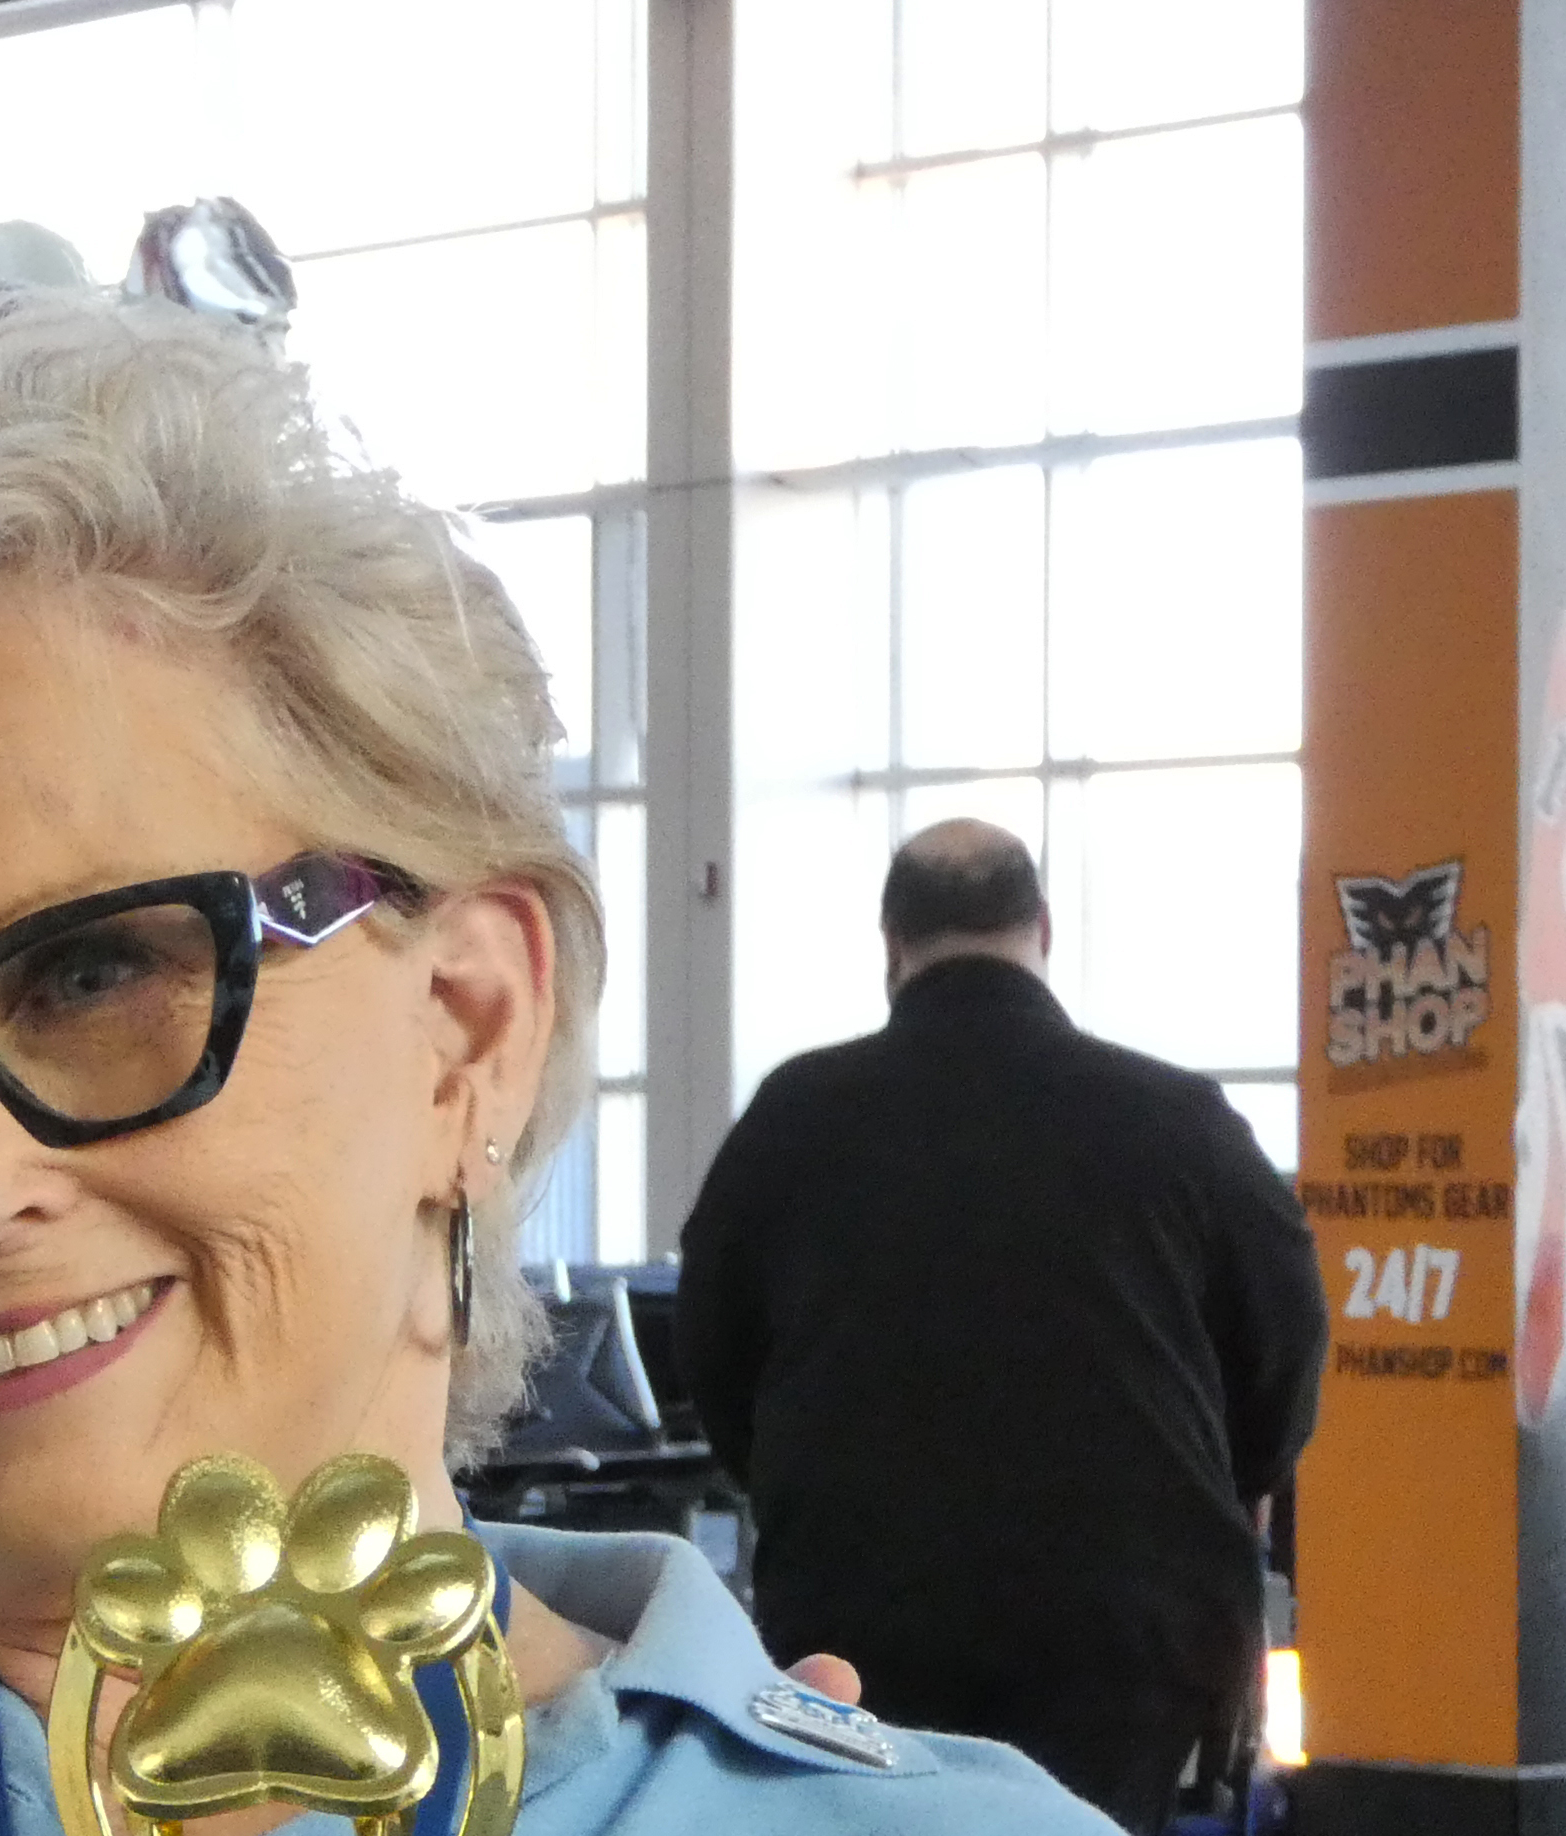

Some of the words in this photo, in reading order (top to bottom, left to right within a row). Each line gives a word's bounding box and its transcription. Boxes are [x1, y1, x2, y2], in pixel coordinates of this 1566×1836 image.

[1329, 926, 1490, 1006] PHAN
[1326, 985, 1490, 1068] SHOP
[1345, 1133, 1409, 1171] SHOP
[1417, 1133, 1462, 1171] FOR
[1343, 1243, 1462, 1325] 24/7
